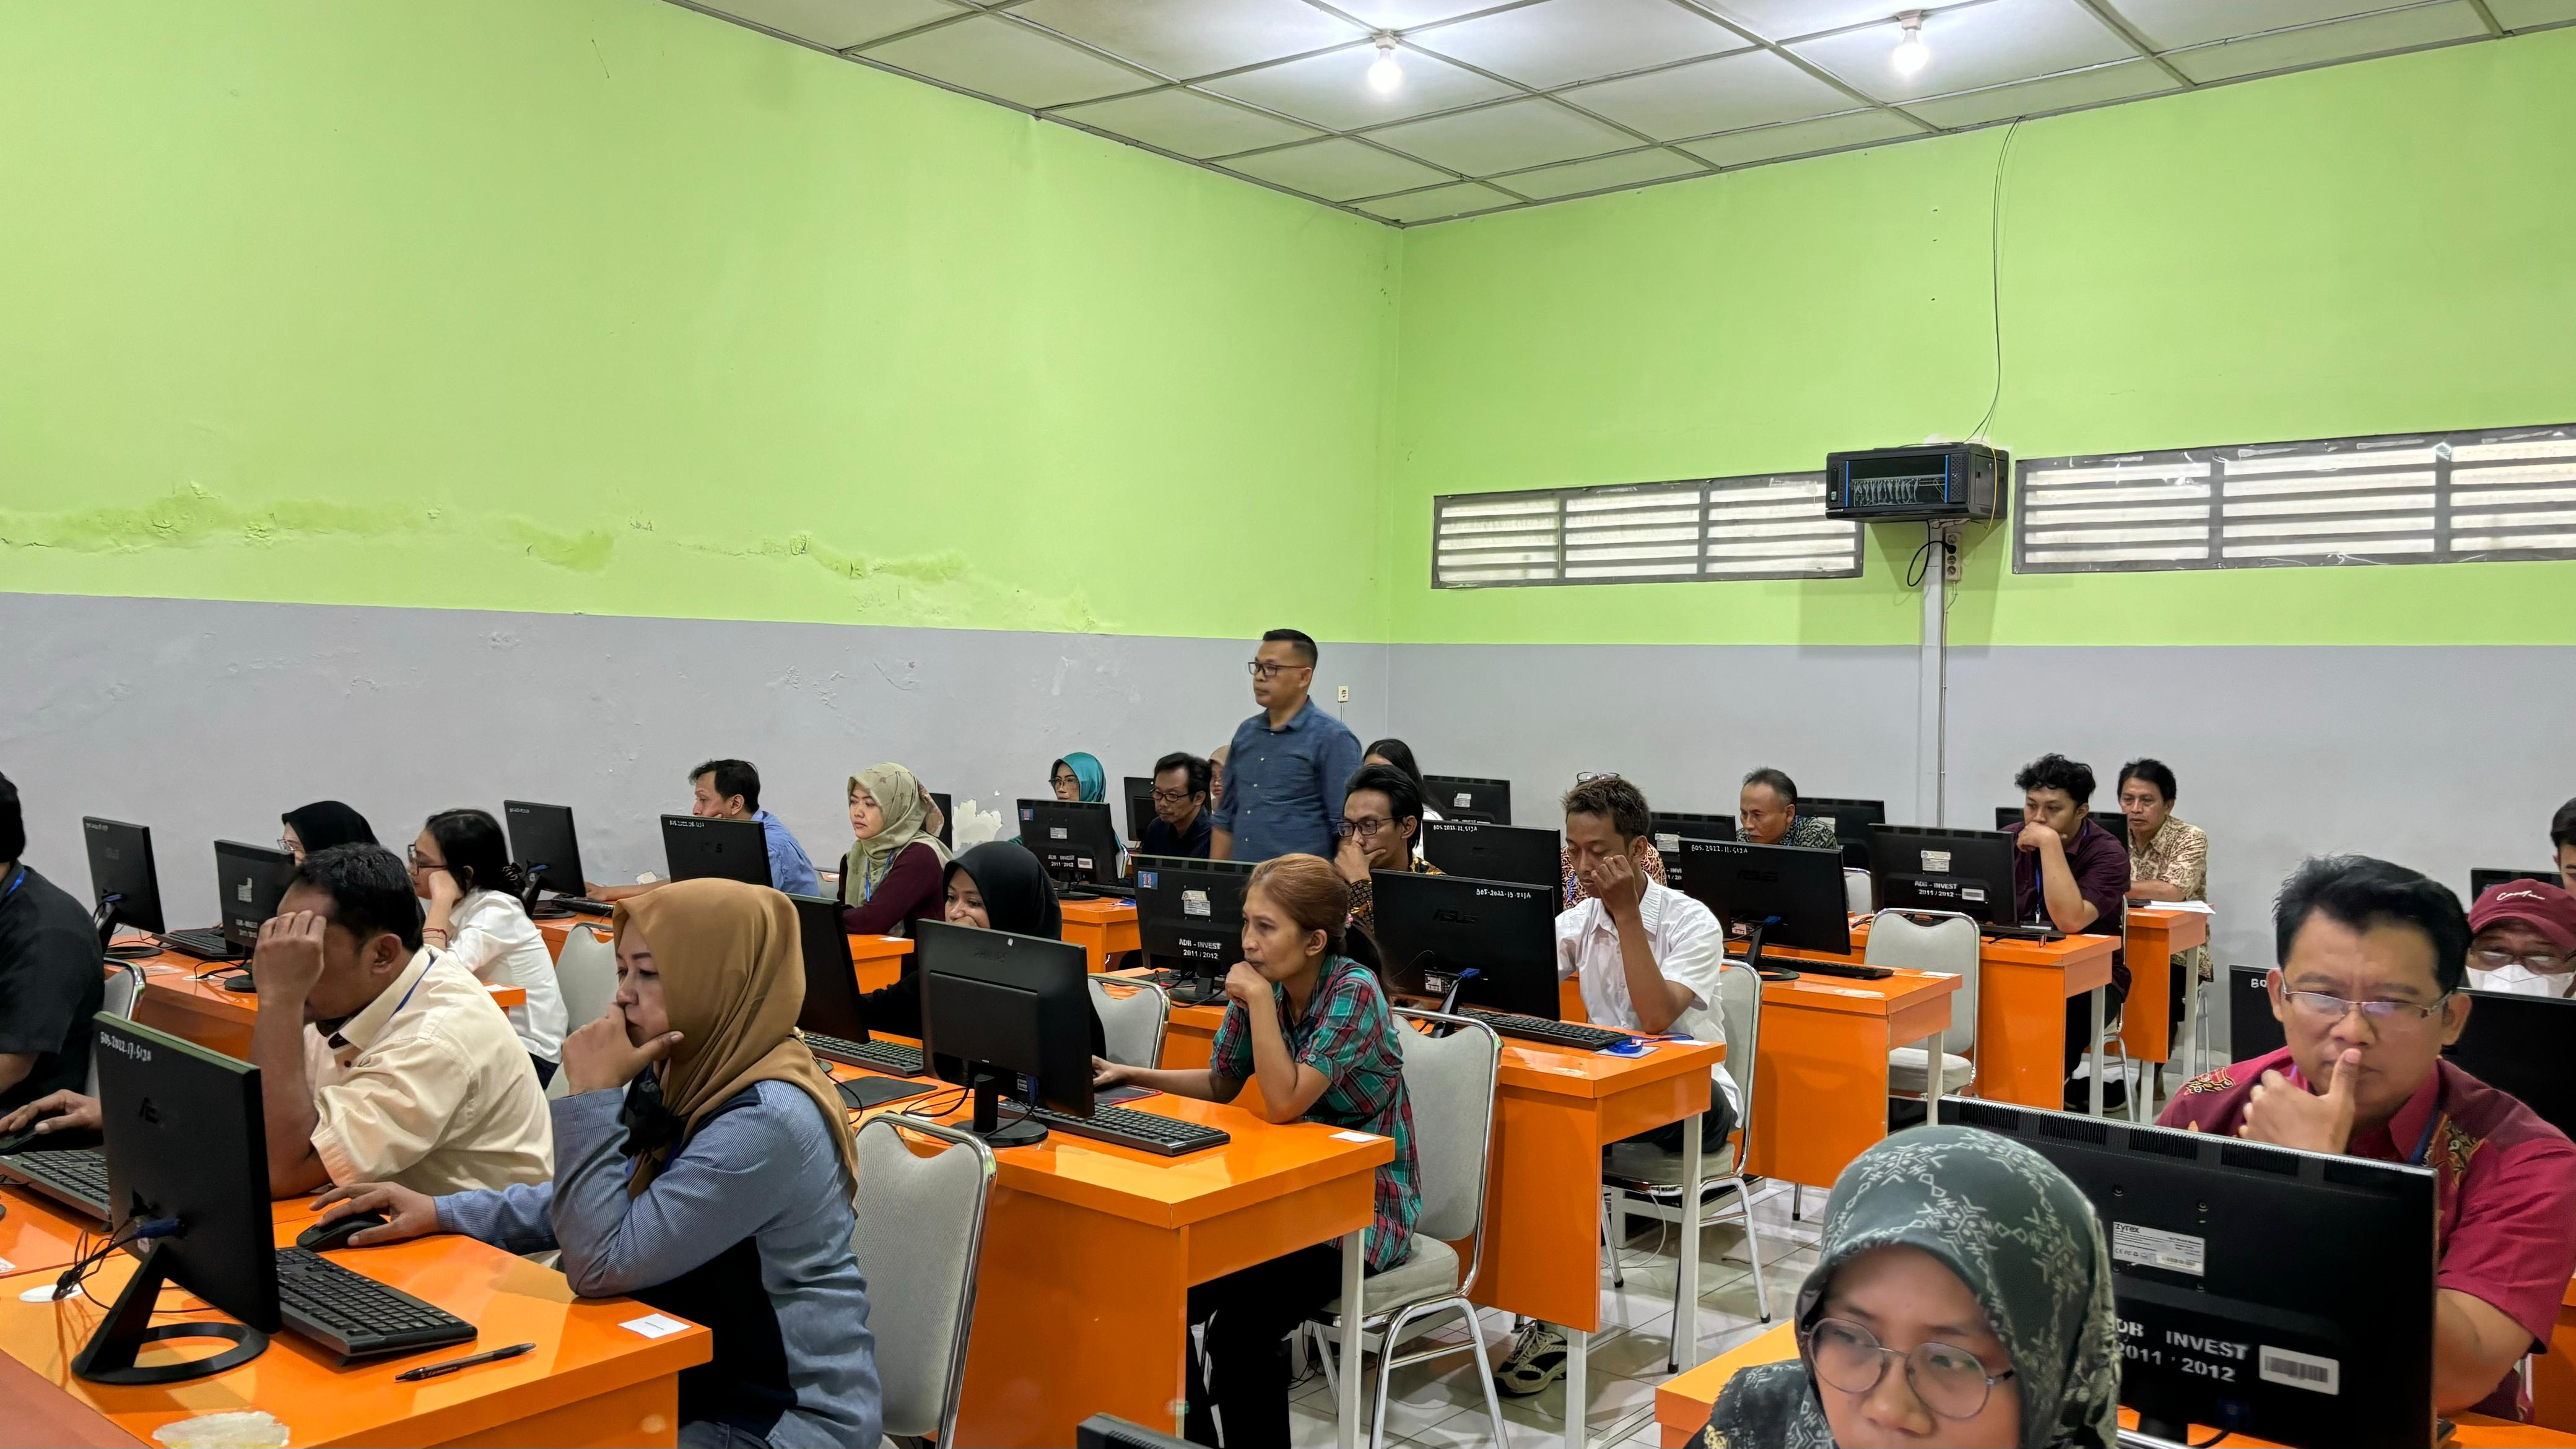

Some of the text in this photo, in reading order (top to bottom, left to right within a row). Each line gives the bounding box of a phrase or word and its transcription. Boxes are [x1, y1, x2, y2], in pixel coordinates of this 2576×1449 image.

[1179, 938, 1192, 947] ADB
[1198, 941, 1222, 950] INVEST
[1183, 949, 1198, 957] 2011
[1203, 952, 1219, 960] 2012
[2251, 978, 2266, 988] BO
[2115, 1318, 2249, 1360] DB INVEST
[2118, 1342, 2236, 1383] 2011 2012
